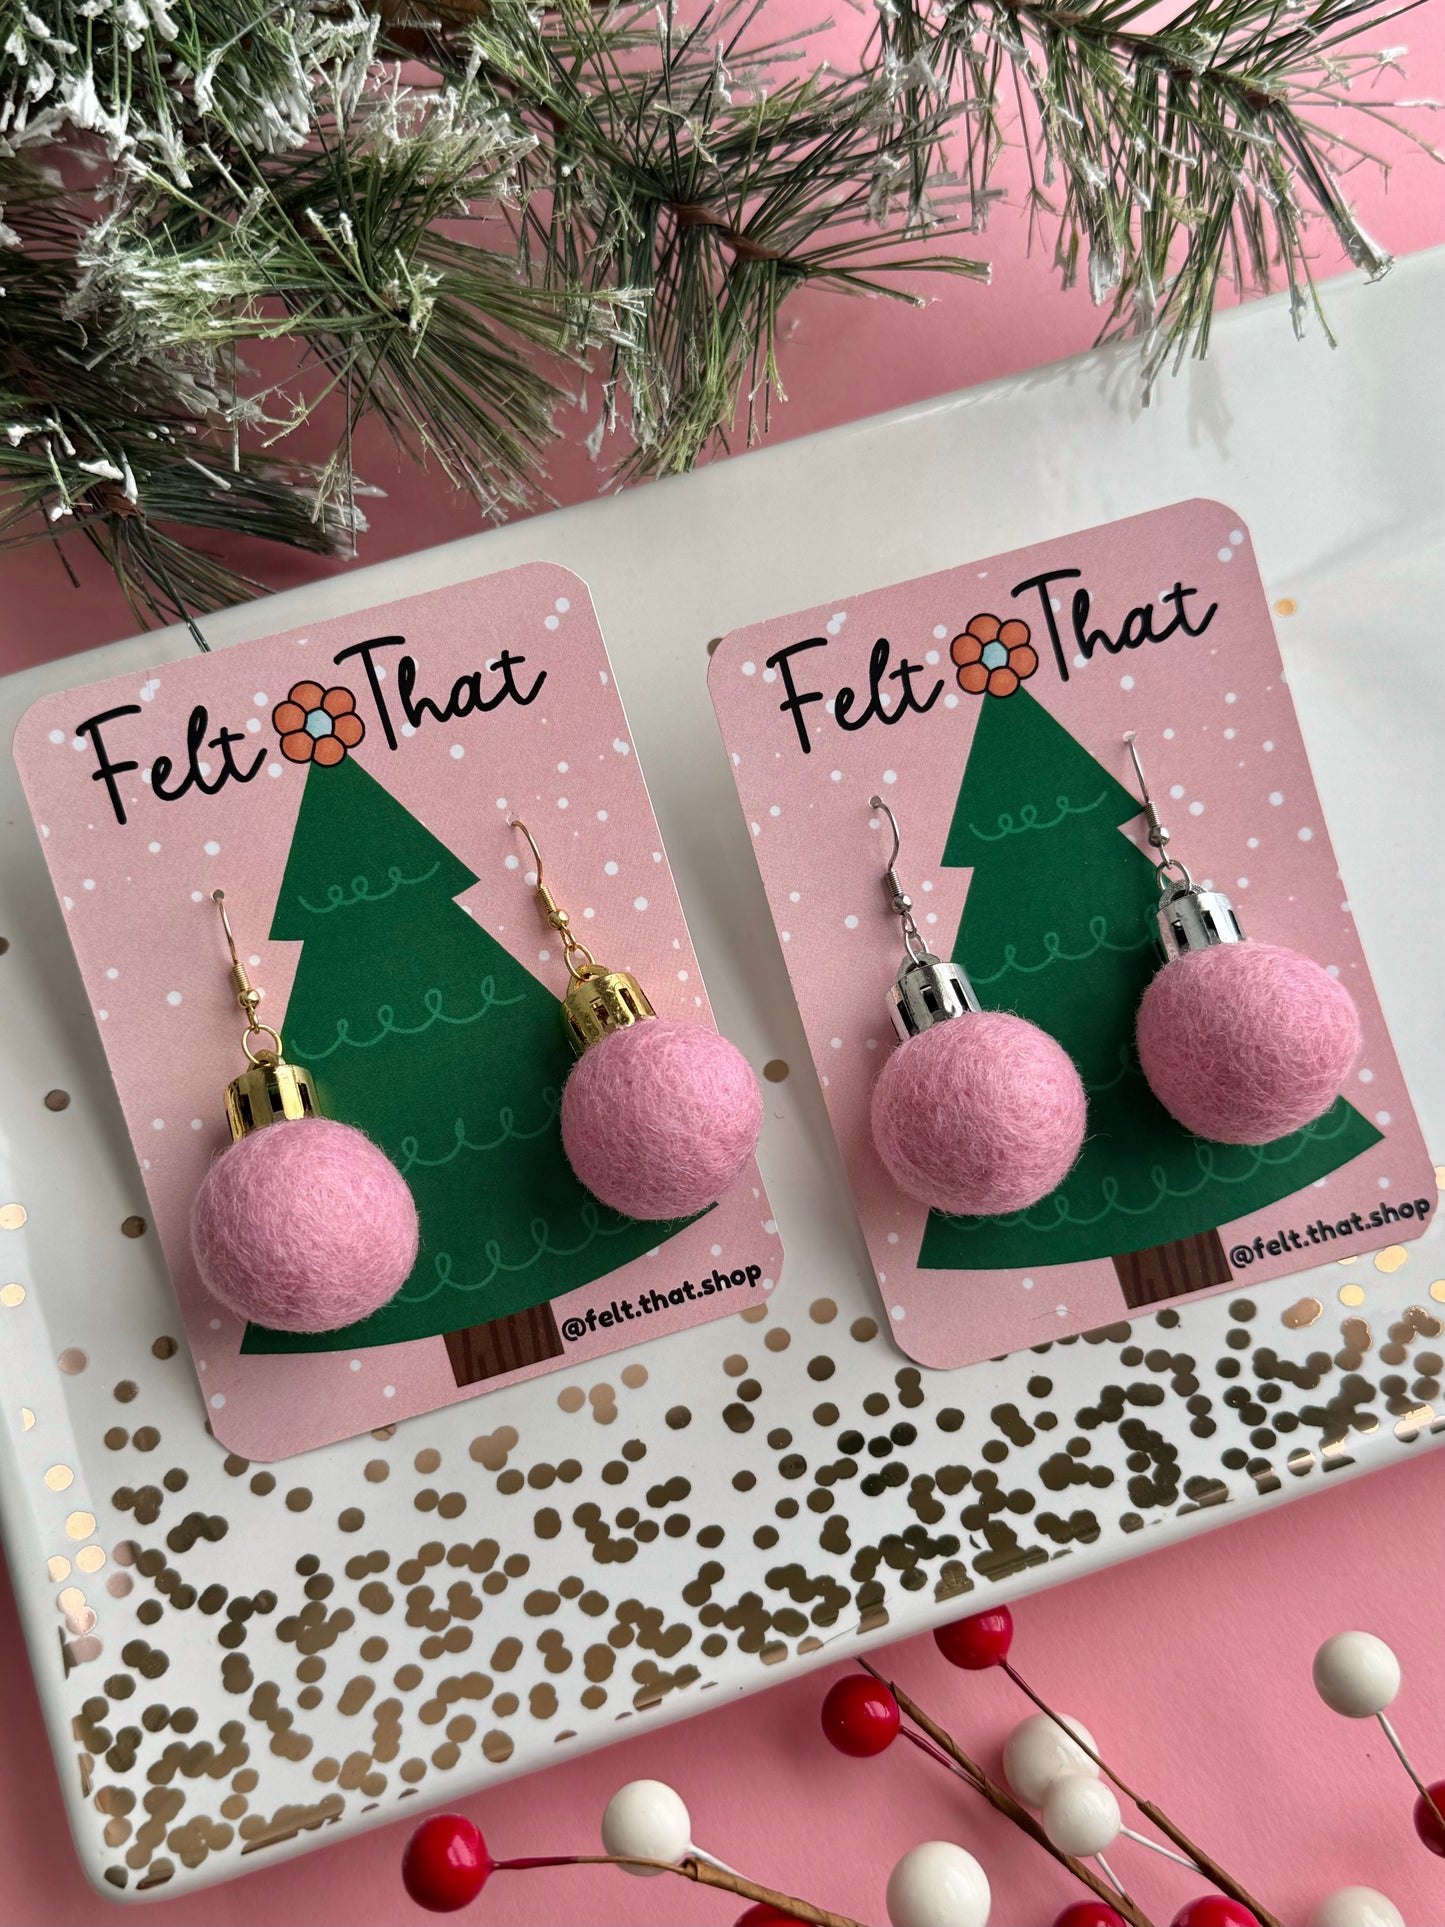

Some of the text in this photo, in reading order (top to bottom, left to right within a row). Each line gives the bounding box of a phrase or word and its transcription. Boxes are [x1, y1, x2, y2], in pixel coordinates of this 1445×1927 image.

[766, 568, 1218, 754] Felt That
[76, 635, 547, 825] Felt That
[1229, 1198, 1431, 1269] @felt.that.shop
[561, 1264, 762, 1341] @felt.that.shop
